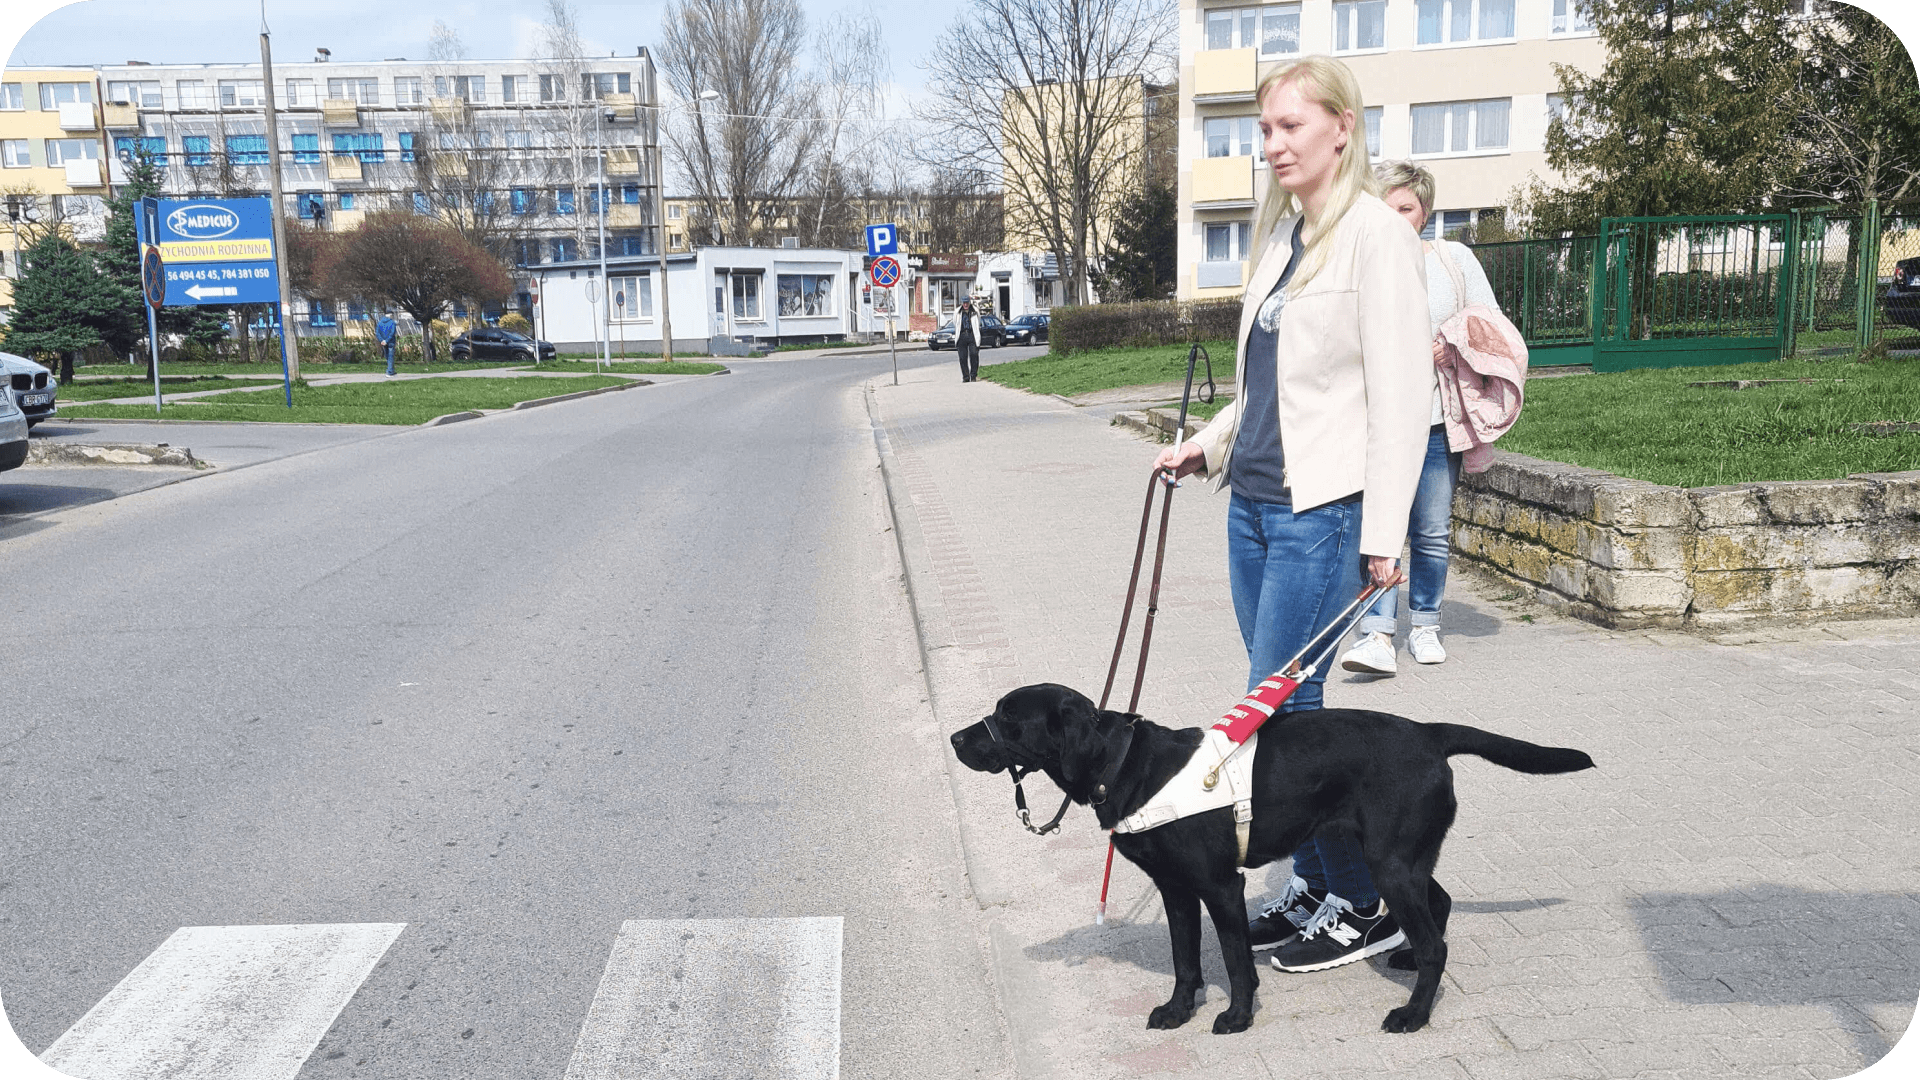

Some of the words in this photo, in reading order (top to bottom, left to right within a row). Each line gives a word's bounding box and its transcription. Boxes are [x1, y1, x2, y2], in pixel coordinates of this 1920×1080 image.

[188, 214, 233, 228] MEDICUS
[873, 227, 891, 253] P
[160, 245, 215, 258] ZYCHODNIA
[218, 243, 268, 256] RODZINNA
[167, 271, 178, 281] 56
[179, 270, 195, 280] 494
[196, 270, 206, 280] 45
[221, 269, 236, 279] 784
[238, 268, 252, 279] 381
[254, 268, 270, 278] 050
